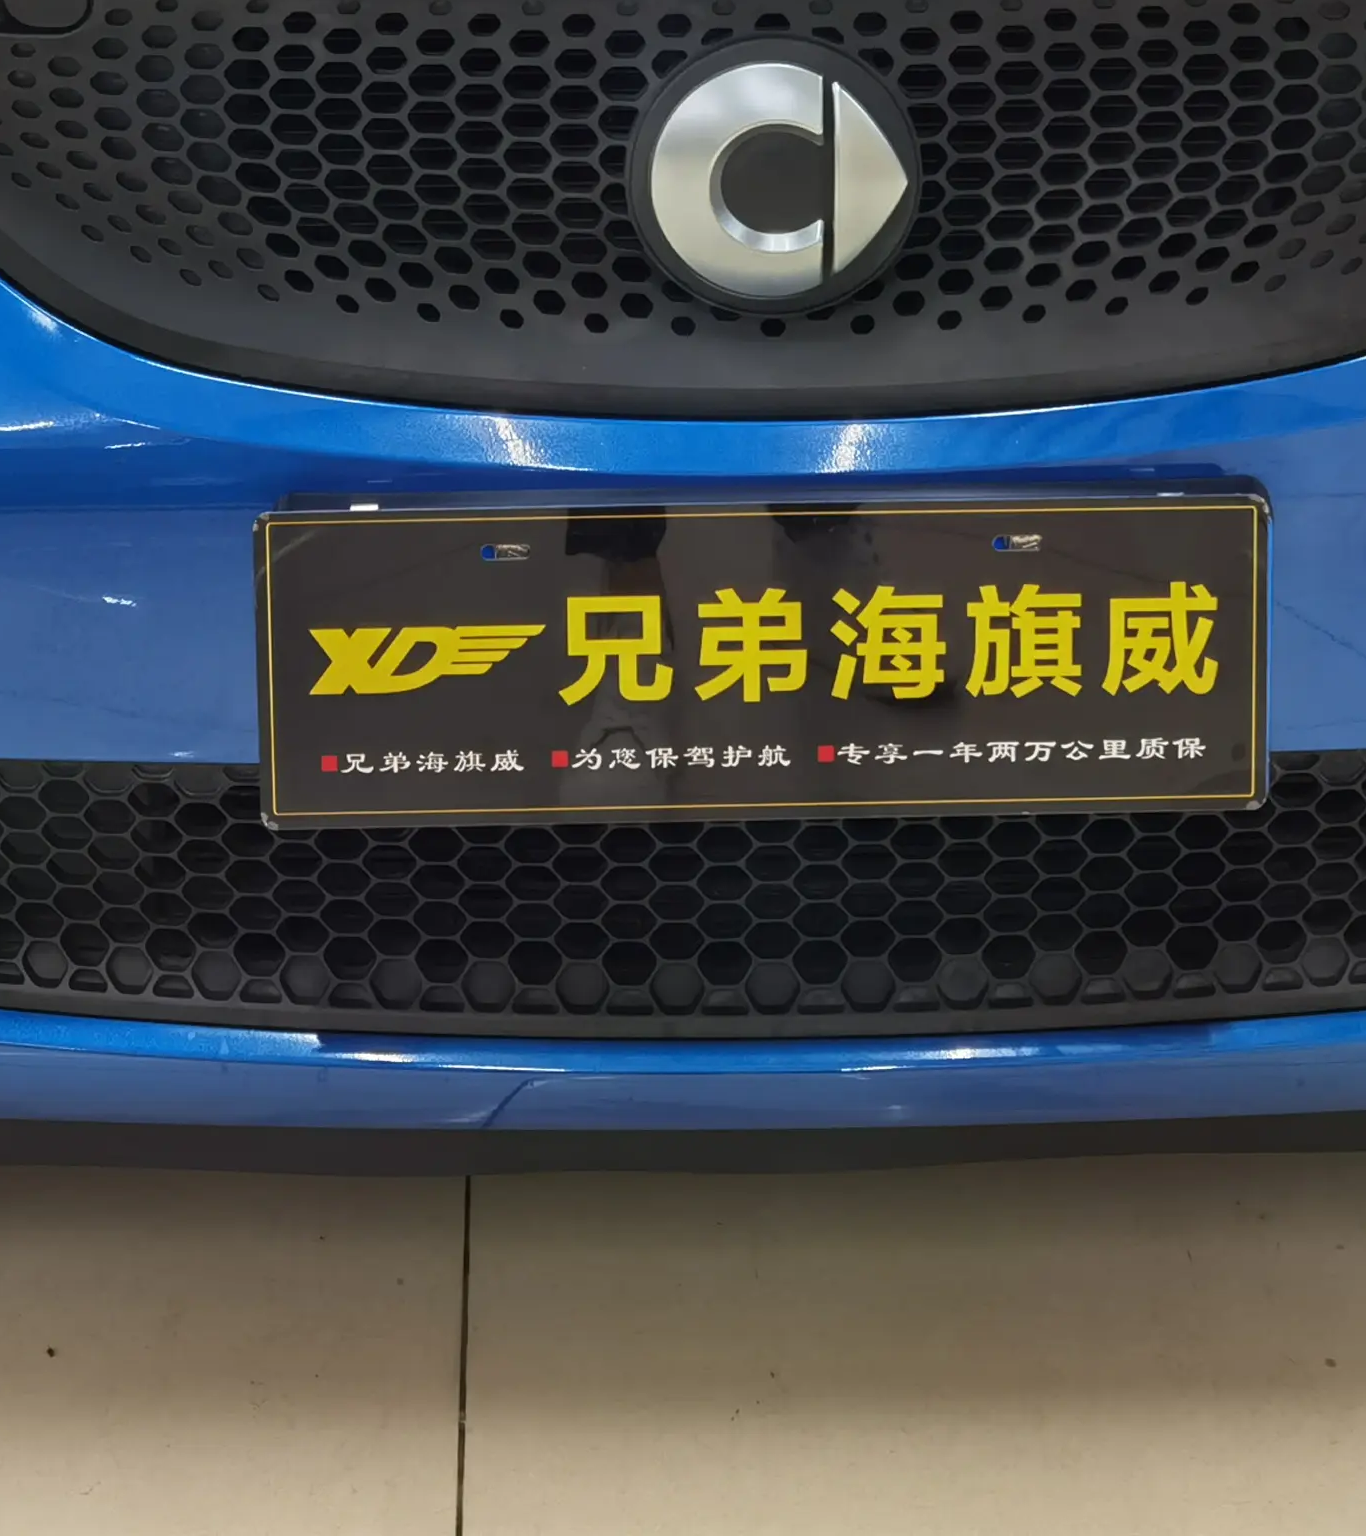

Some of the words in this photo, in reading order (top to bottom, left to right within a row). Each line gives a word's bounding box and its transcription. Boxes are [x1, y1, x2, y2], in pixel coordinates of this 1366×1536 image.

[557, 580, 1219, 706] 兄弟海旗威
[341, 749, 525, 773] 兄弟海旗威
[571, 745, 792, 769] 为您保驾护航
[837, 736, 1207, 765] 专享一年两万公里质保
